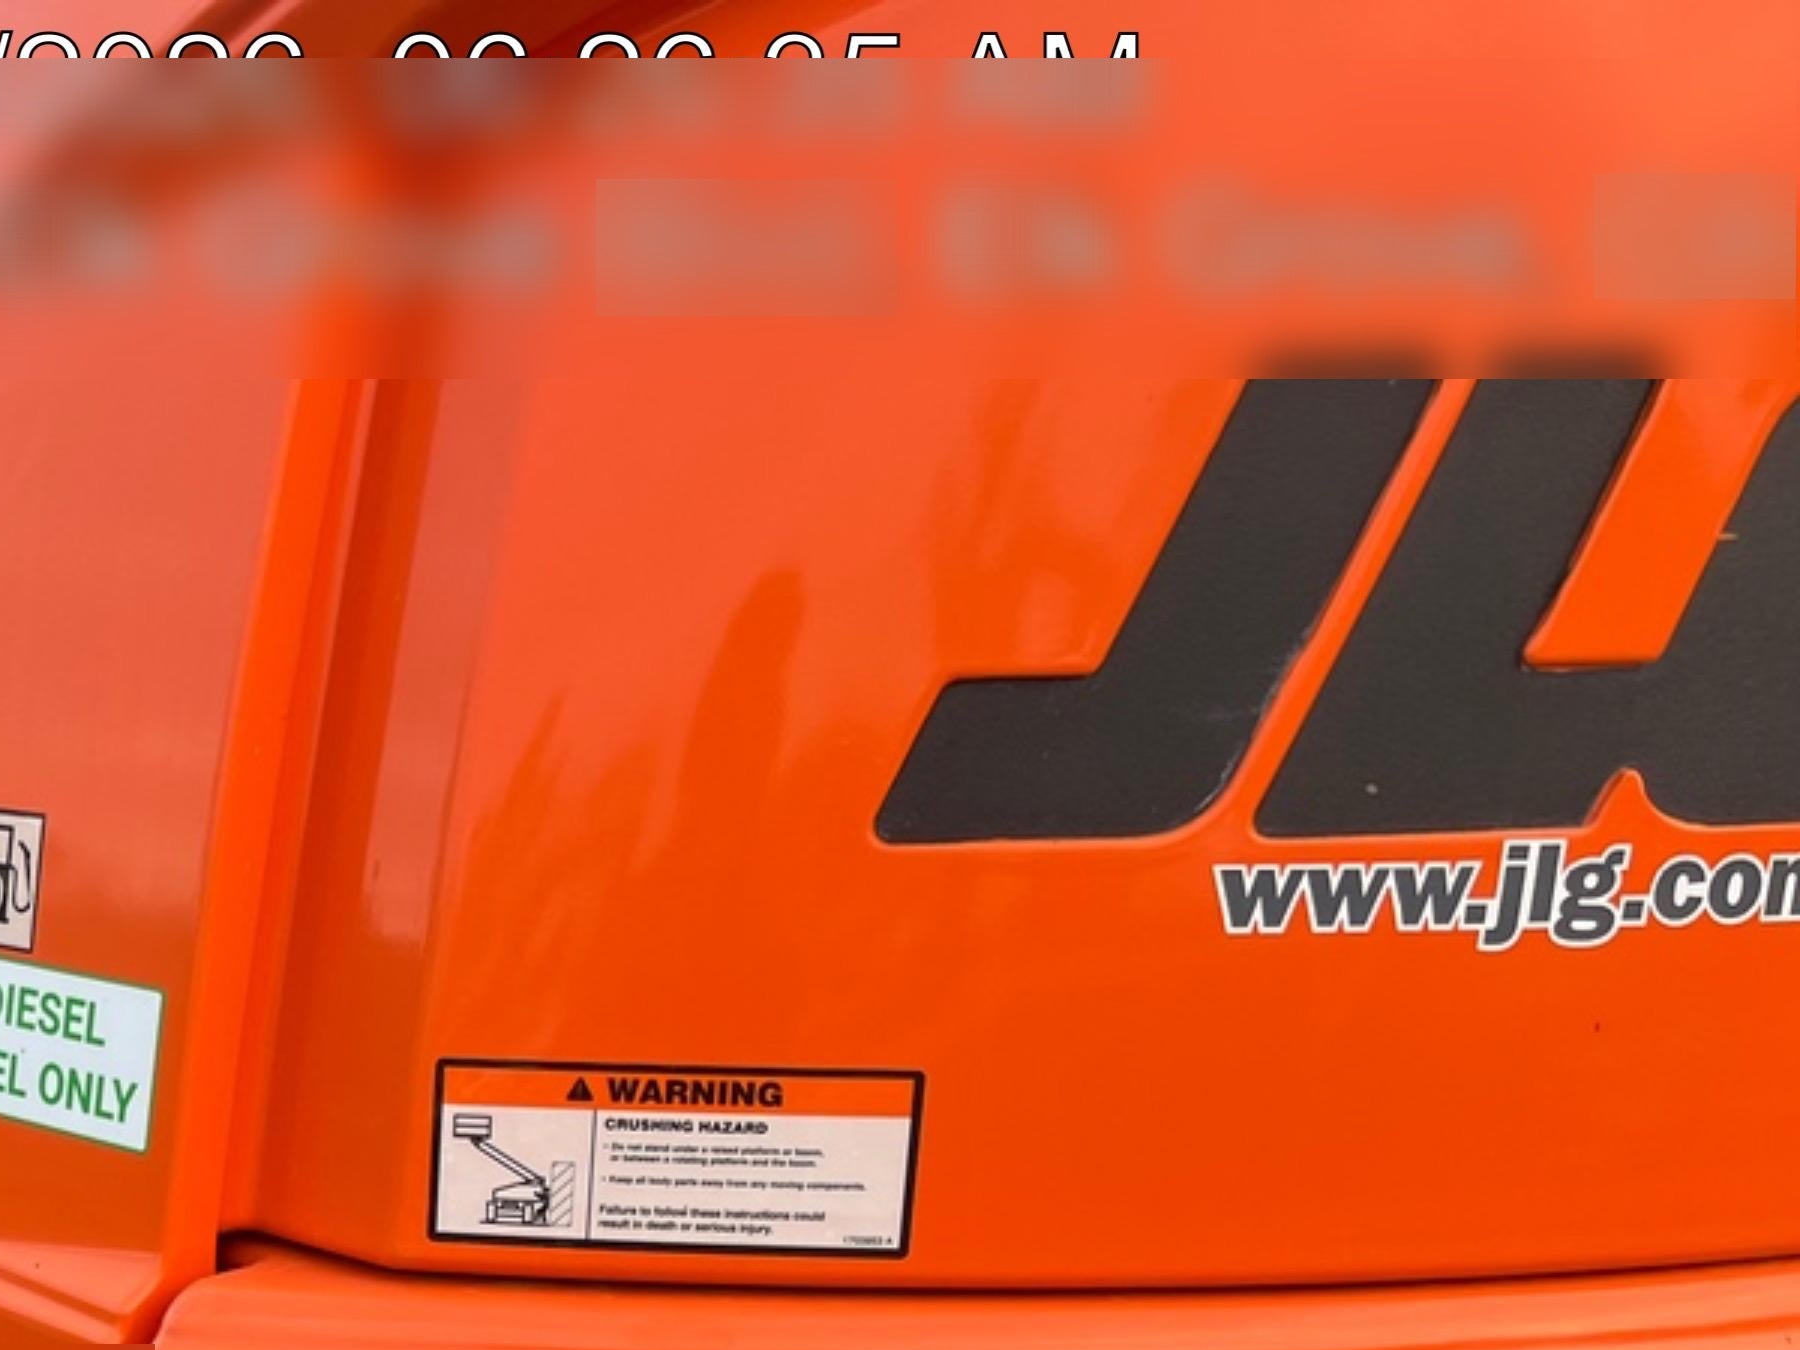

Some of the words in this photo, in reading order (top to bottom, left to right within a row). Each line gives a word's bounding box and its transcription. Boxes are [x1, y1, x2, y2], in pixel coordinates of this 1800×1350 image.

[38, 1062, 138, 1123] ONLY
[608, 1077, 784, 1108] WARNING
[604, 1118, 694, 1133] CRUSHING
[698, 1119, 769, 1135] HAZARD
[599, 1203, 637, 1215] Failure
[640, 1206, 651, 1216] to
[653, 1205, 688, 1217] follow
[689, 1207, 721, 1218] these
[724, 1208, 790, 1220] instructions
[793, 1211, 826, 1221] could
[598, 1219, 630, 1228] result
[632, 1220, 642, 1229] in
[645, 1220, 678, 1230] death
[680, 1223, 691, 1231] or
[695, 1223, 736, 1233] serious
